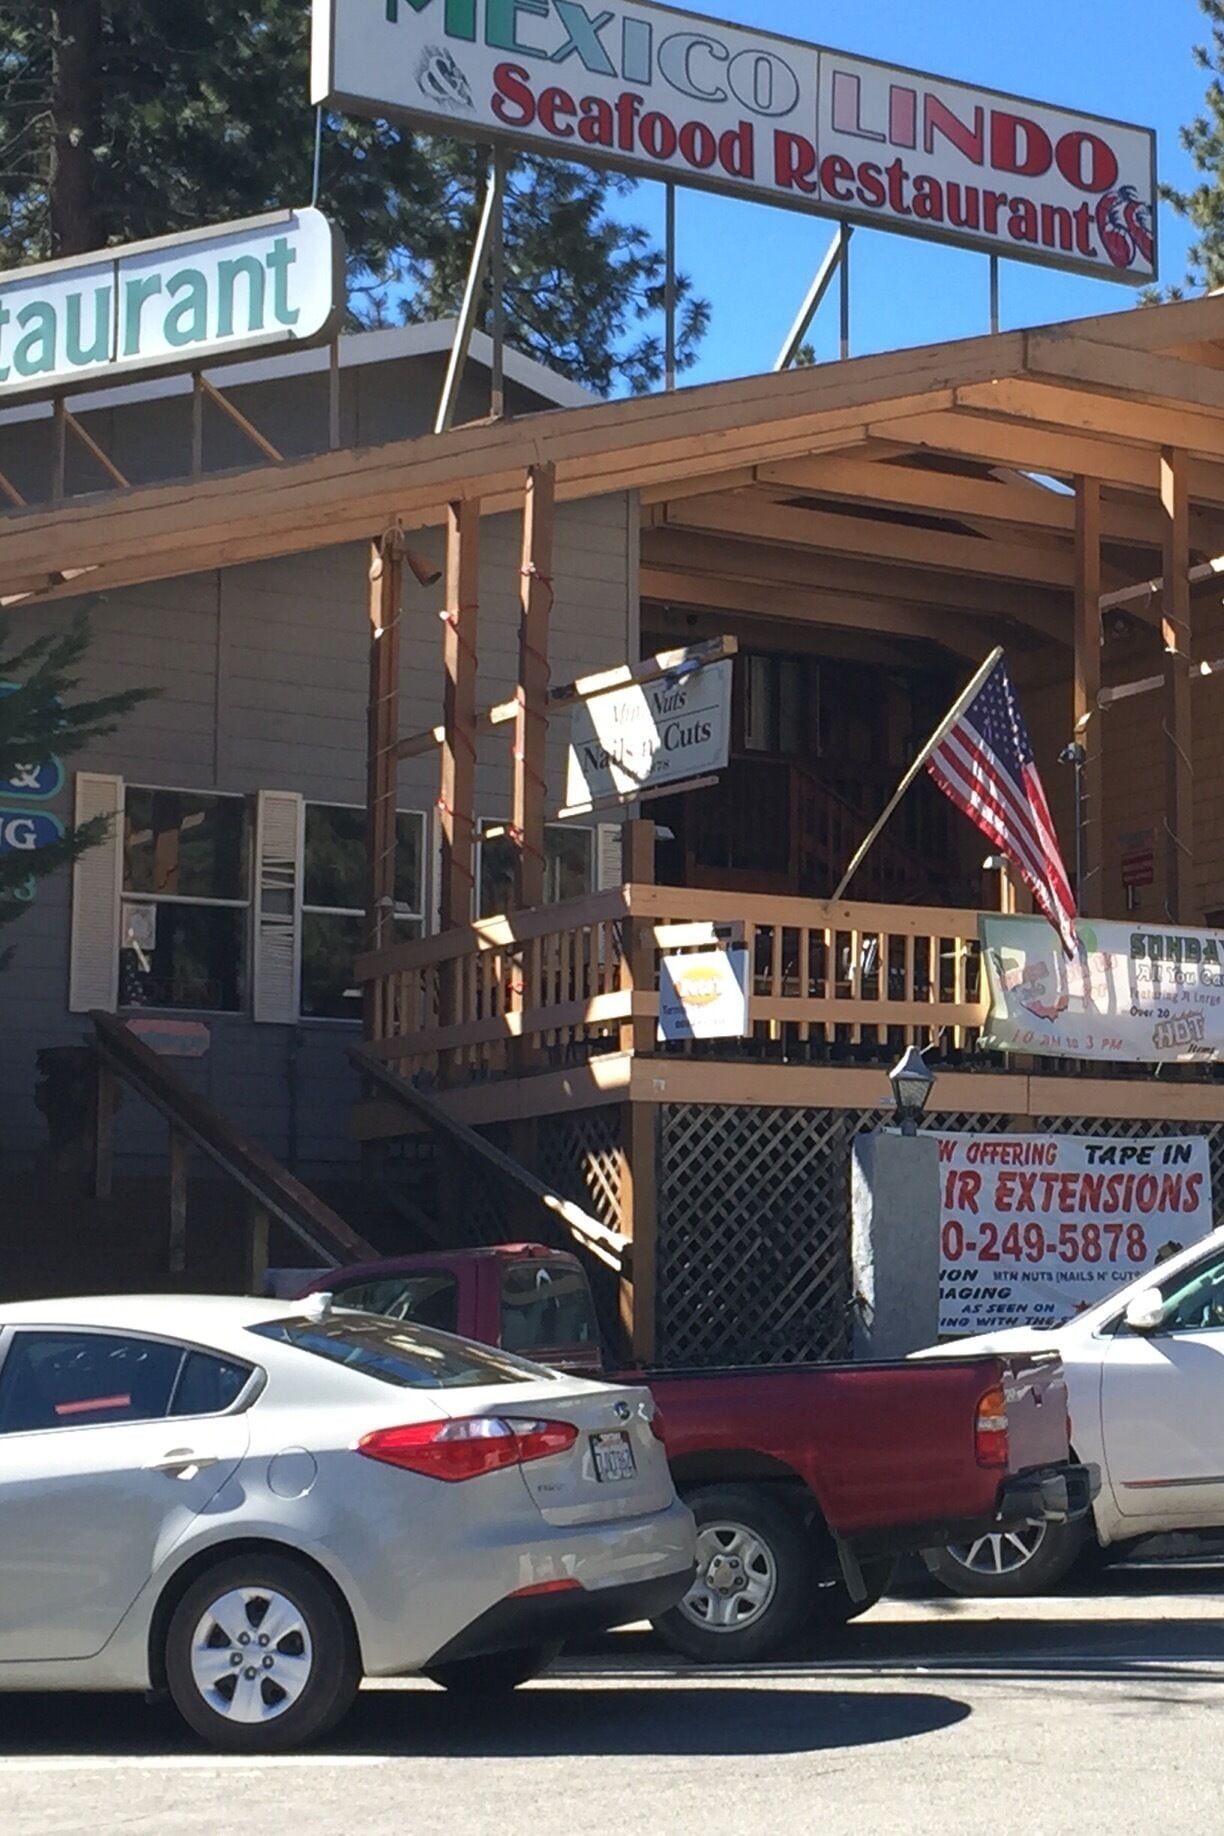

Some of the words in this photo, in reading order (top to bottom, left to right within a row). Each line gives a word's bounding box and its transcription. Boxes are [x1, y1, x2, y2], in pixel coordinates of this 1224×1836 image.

[831, 70, 1119, 194] LINDO
[490, 62, 754, 180] Seafood
[773, 128, 1098, 258] Restaurant
[653, 690, 688, 715] Nuts
[664, 721, 712, 752] Cuts
[0, 818, 37, 850] G
[1136, 963, 1163, 983] All
[1167, 965, 1197, 985] You
[1129, 1005, 1154, 1018] Over
[1156, 1007, 1171, 1019] 20
[1012, 1029, 1034, 1044] 10
[1085, 1035, 1094, 1049] 3
[1102, 1038, 1124, 1051] PM
[1154, 1014, 1205, 1050] HOT
[938, 1139, 958, 1163] W
[966, 1141, 1058, 1167] OFFERING
[1084, 1144, 1152, 1166] TAPE
[1162, 1144, 1193, 1165] IN
[943, 1169, 982, 1215] IR
[994, 1171, 1204, 1214] EXTENSIONS
[942, 1220, 1148, 1264] 0-249-5878
[939, 1316, 971, 1327] ING
[975, 1316, 1018, 1326] WITH
[1024, 1316, 1056, 1326] THE
[961, 1304, 982, 1314] AS
[988, 1304, 1029, 1314] SEEN
[1033, 1303, 1055, 1313] ON
